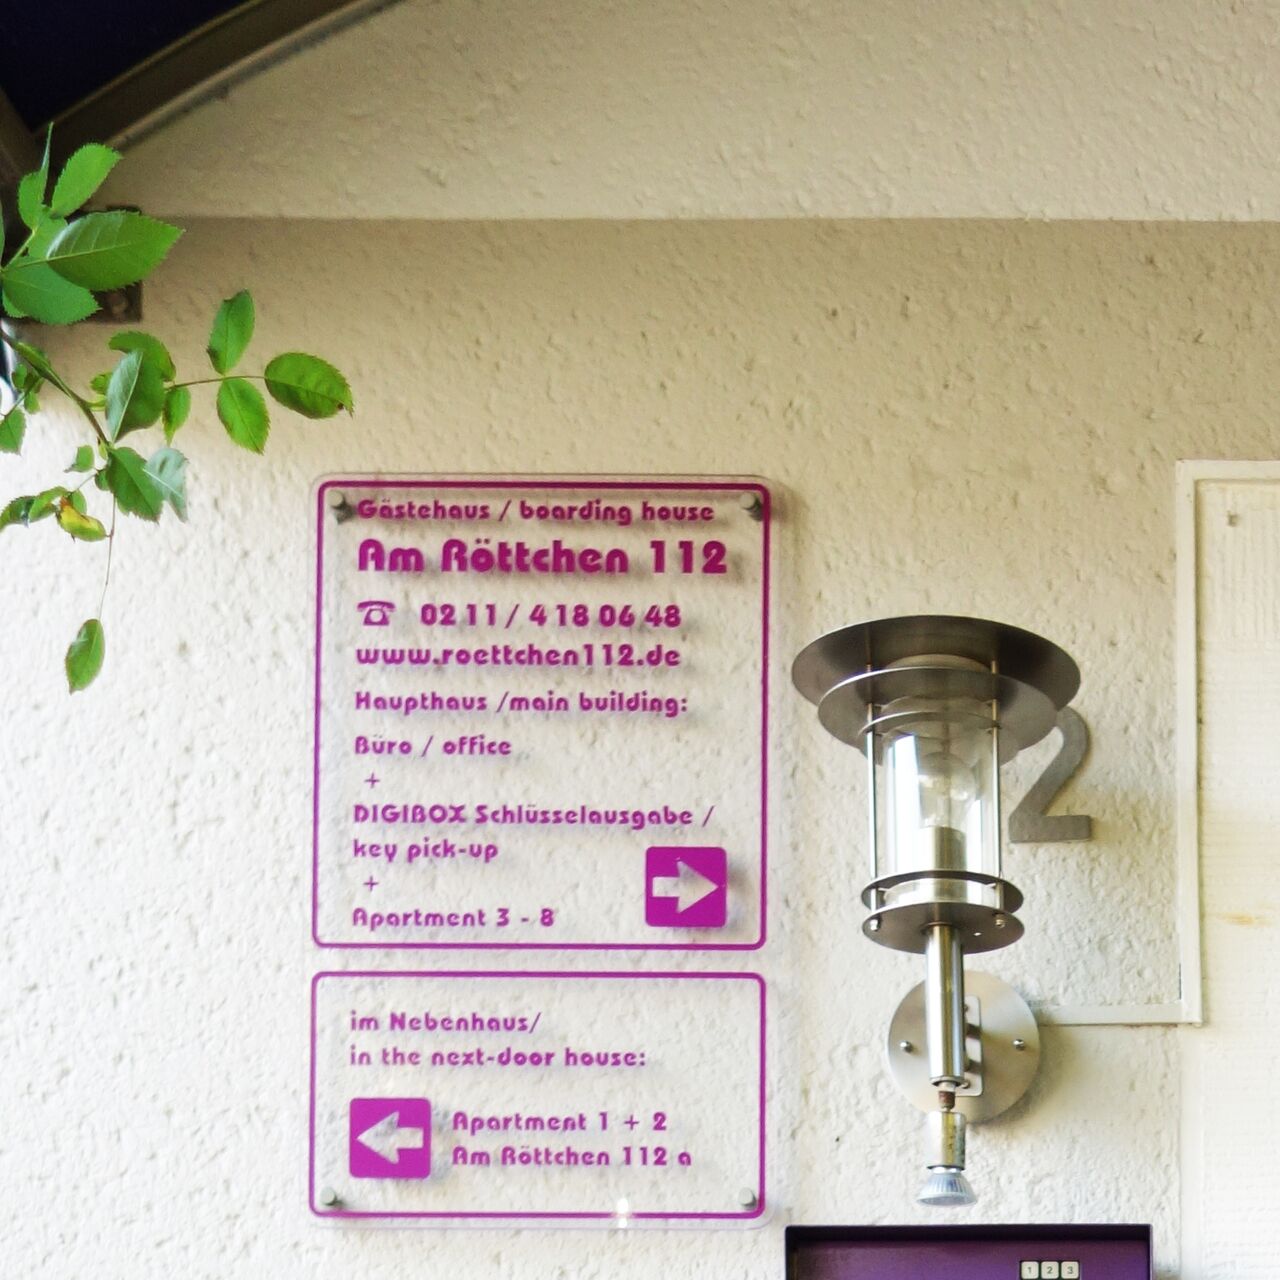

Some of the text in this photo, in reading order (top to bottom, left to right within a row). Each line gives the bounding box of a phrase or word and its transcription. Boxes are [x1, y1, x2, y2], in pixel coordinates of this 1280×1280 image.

[355, 498, 715, 526] Gästehaus / boarding house
[358, 537, 728, 575] Am Röttchen 112
[355, 643, 681, 668] www.roettchen112.de
[354, 691, 488, 716] Haupthaus
[579, 690, 688, 719] building:
[353, 734, 512, 757] Büro / office
[353, 803, 715, 831] DIGIBOX Schlüsselausgabe /
[352, 838, 499, 864] key pick-up
[352, 907, 486, 930] Apartment
[496, 907, 511, 928] 3
[539, 907, 555, 928] 8
[350, 1010, 380, 1031] im
[350, 1047, 647, 1067] in the next-door house:
[452, 1111, 668, 1135] Apartment 1 + 2
[452, 1144, 692, 1167] Am Röttchen 112 a
[1046, 1266, 1053, 1274] 2
[1067, 1266, 1073, 1274] 3
